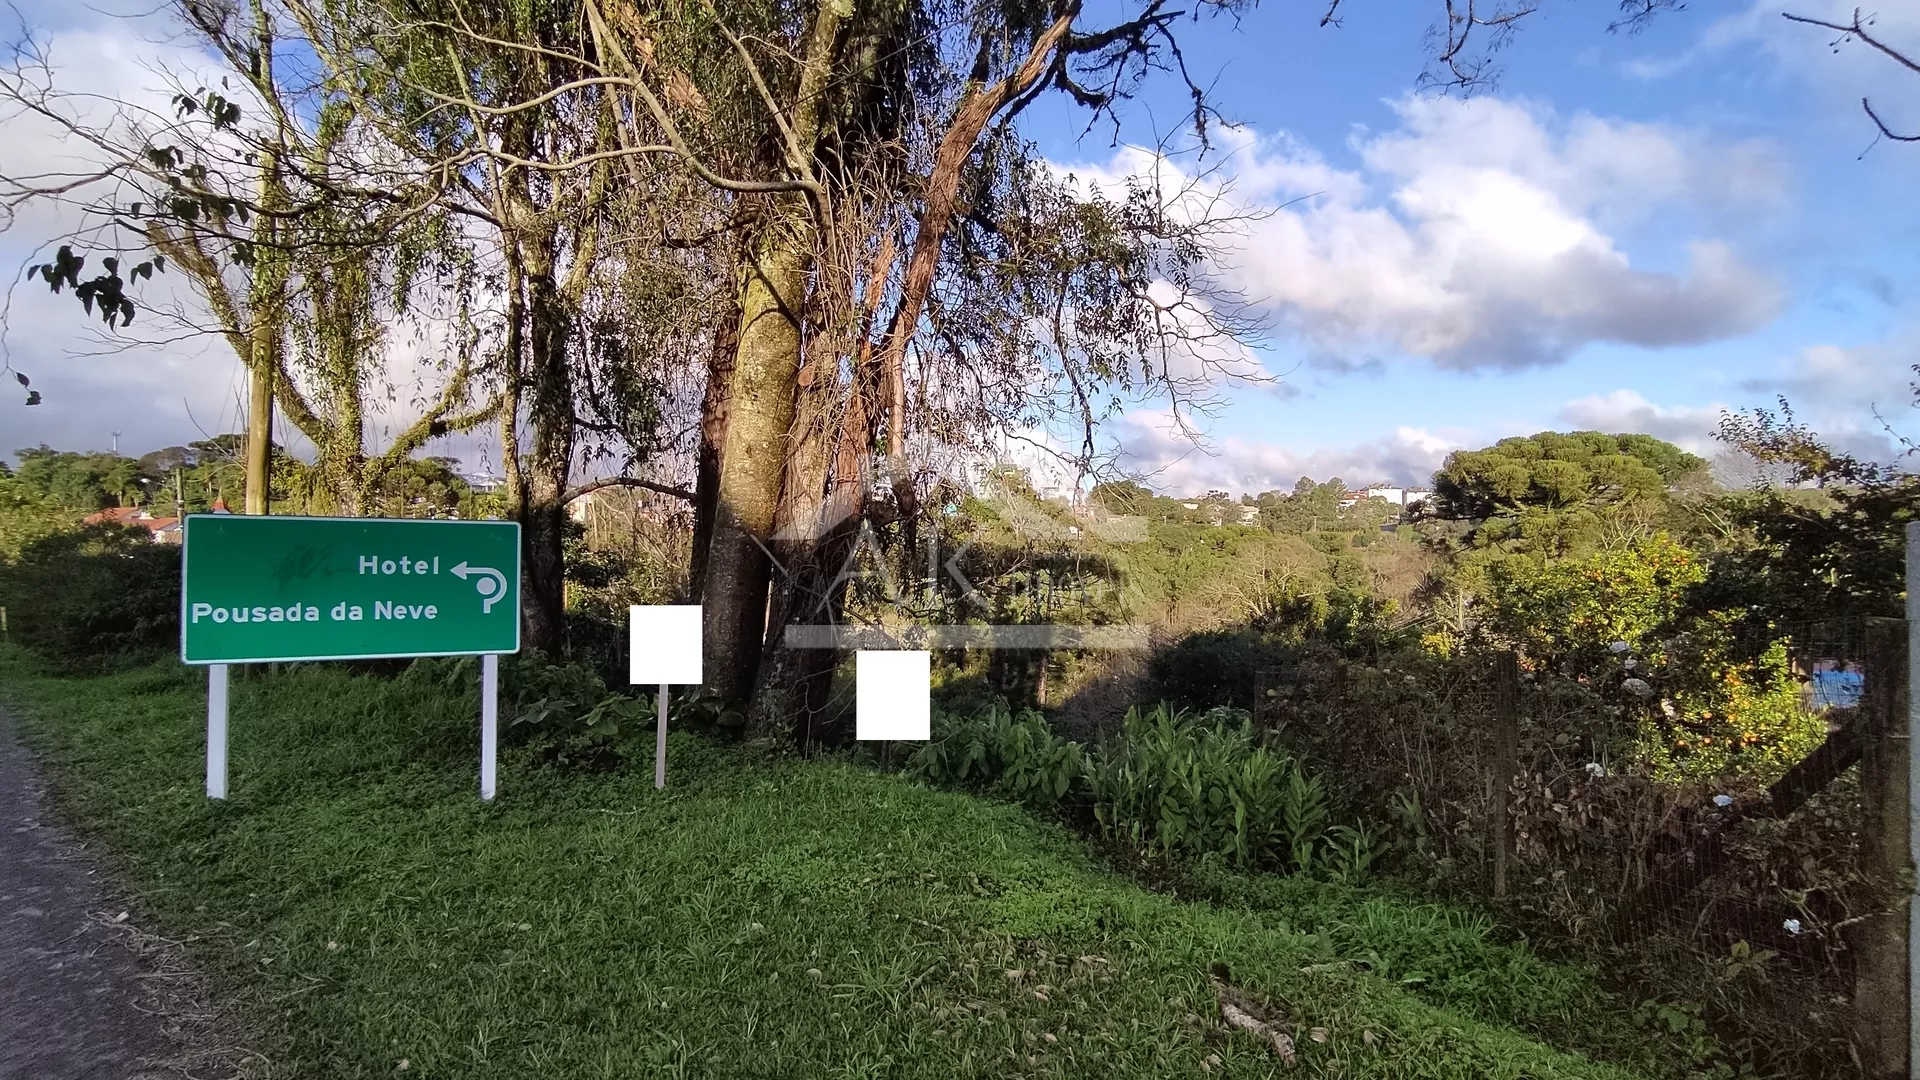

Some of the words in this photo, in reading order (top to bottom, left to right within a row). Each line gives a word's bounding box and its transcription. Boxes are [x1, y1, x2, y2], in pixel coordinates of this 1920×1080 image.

[359, 555, 439, 575] Hotel
[192, 602, 319, 624] Pousada
[330, 601, 363, 621] da
[374, 600, 438, 620] Neve
